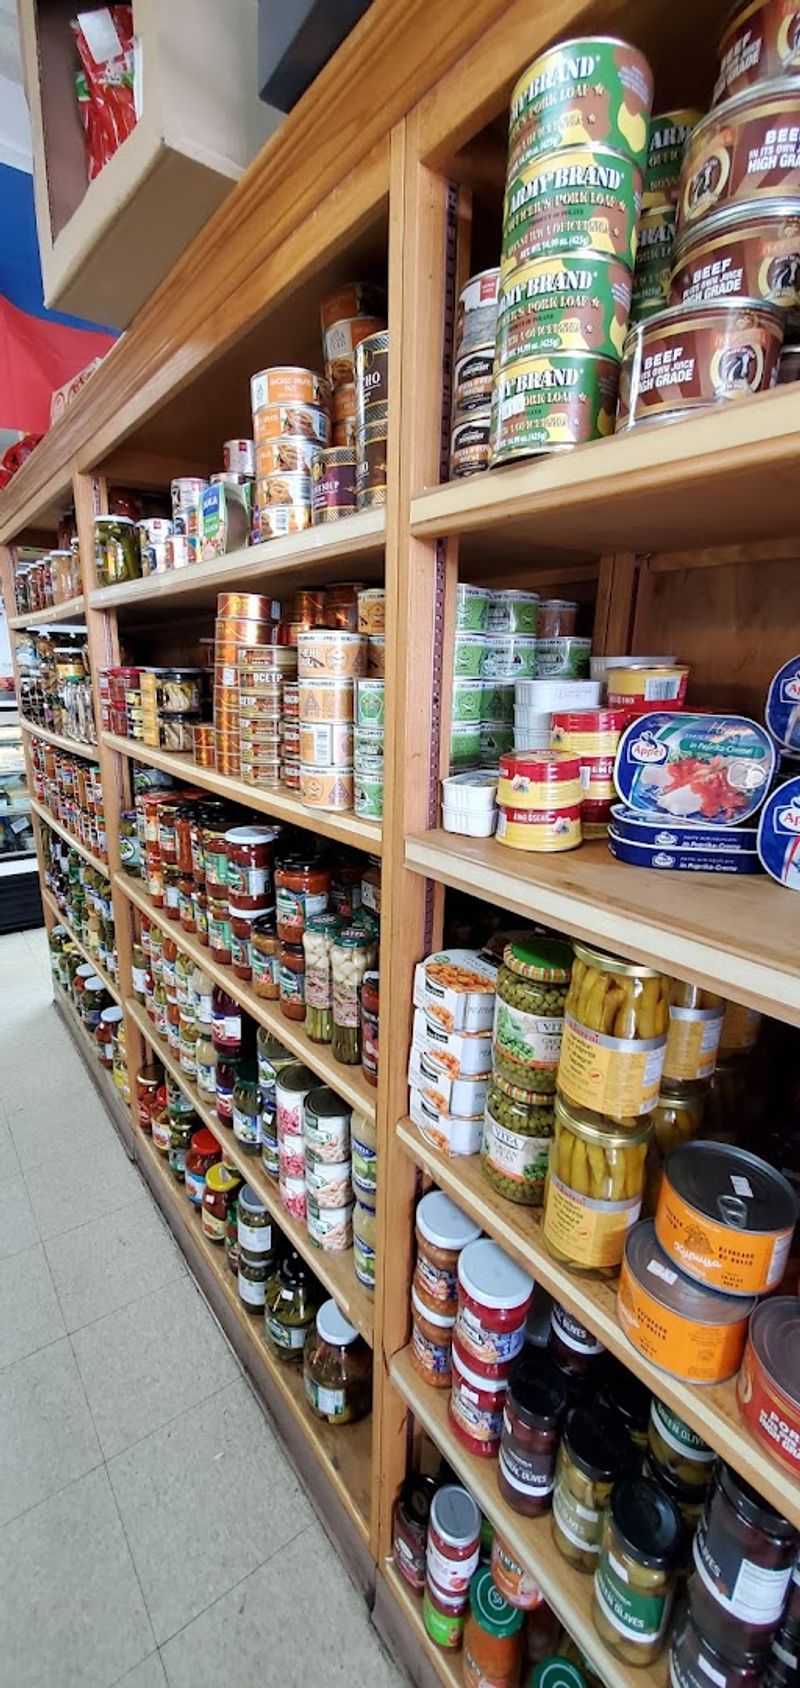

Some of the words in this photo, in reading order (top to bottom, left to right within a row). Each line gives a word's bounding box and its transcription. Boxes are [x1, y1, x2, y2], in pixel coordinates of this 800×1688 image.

[529, 55, 596, 103] BRAND
[765, 127, 800, 145] BEE
[747, 154, 778, 174] HIGH
[553, 165, 622, 190] BRAND
[554, 192, 588, 208] PORK
[693, 258, 733, 284] BEEF
[527, 271, 593, 299] BRAND
[704, 280, 742, 301] GRADE
[645, 347, 685, 370] BEEF
[517, 368, 579, 393] BRAND
[655, 370, 694, 388] GRADE
[526, 393, 547, 406] ORK
[634, 744, 665, 758] Appel
[495, 1126, 519, 1147] VITA
[615, 1602, 645, 1629] OLIVES
